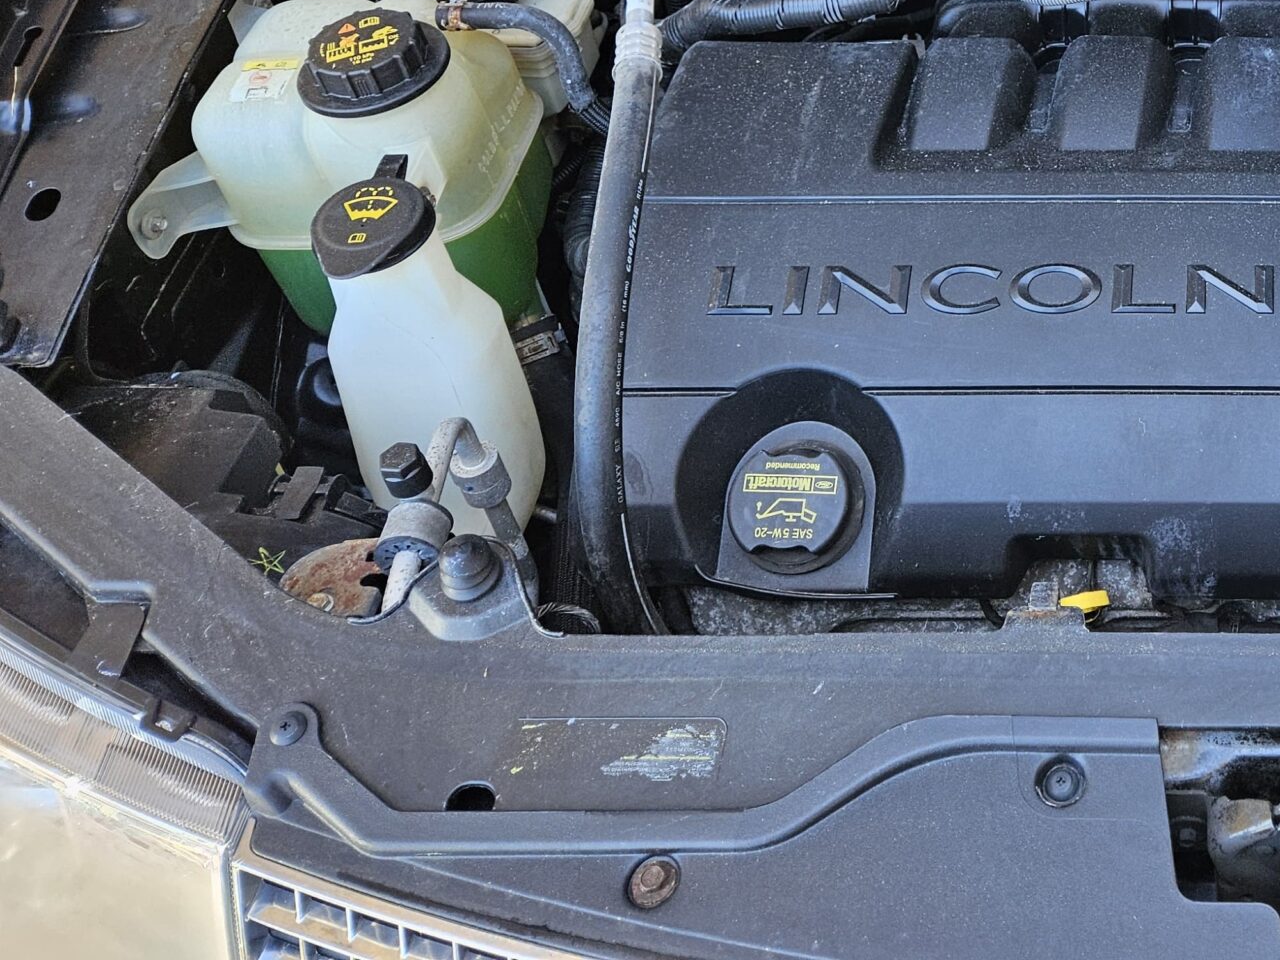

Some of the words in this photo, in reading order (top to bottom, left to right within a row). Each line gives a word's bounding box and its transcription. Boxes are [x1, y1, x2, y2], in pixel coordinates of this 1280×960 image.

[707, 263, 1275, 315] LINCOLN
[615, 464, 624, 503] GALAXY
[626, 205, 640, 272] GOODYEAR
[765, 461, 820, 471] Recommended
[747, 476, 812, 490] Motorcraft
[755, 527, 790, 538] 5W-20
[792, 529, 813, 539] SAE
